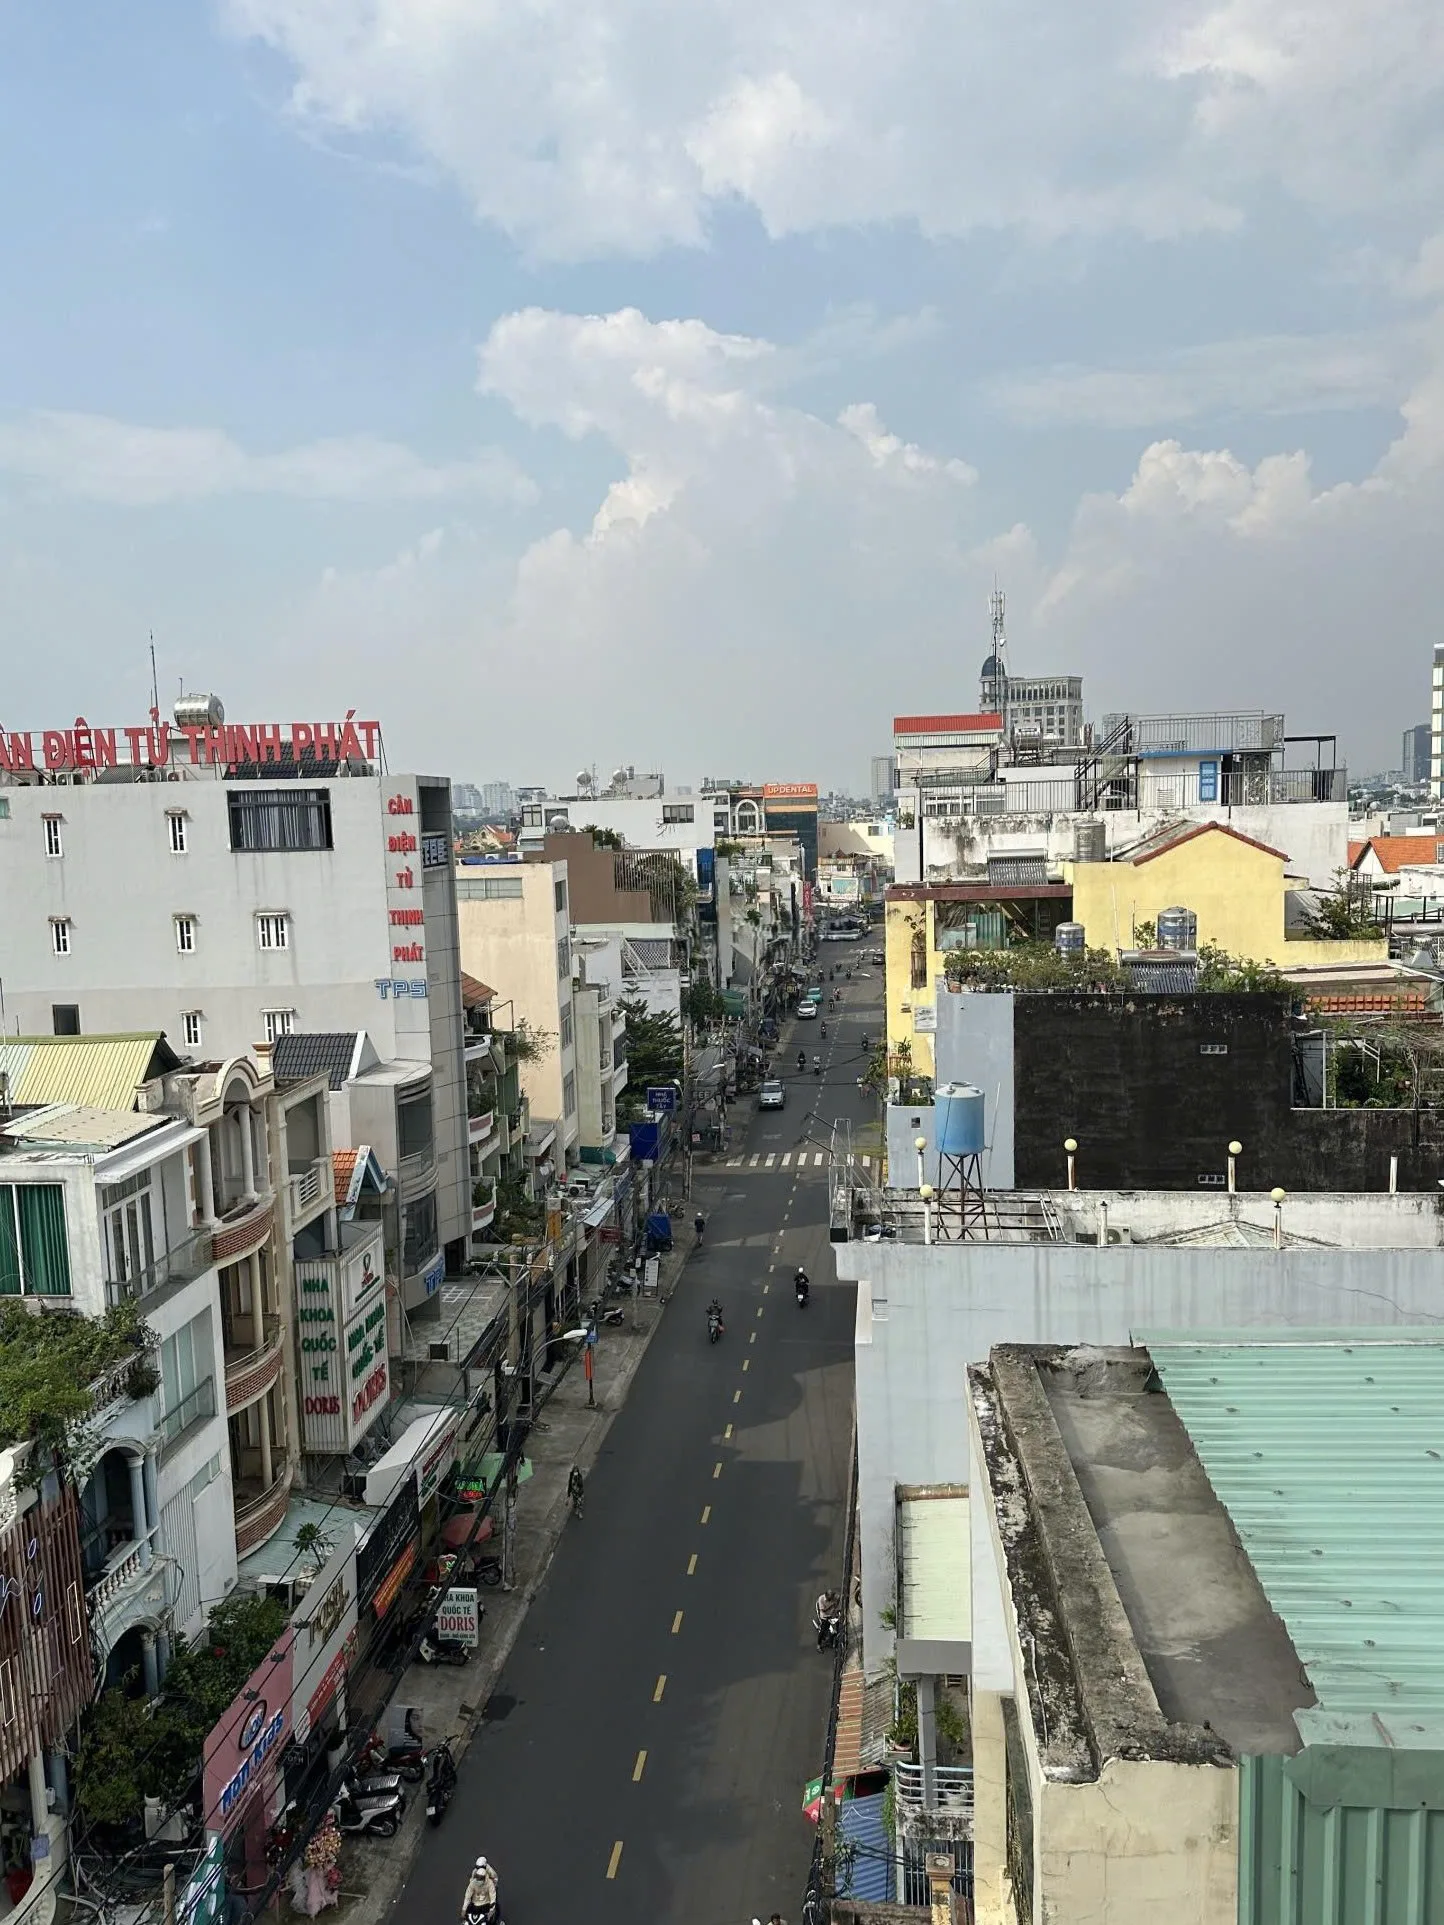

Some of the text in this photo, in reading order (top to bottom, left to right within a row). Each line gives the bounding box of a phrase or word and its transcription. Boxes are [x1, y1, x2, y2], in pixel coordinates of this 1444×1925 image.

[43, 717, 117, 777] ĐIỆN
[125, 707, 170, 768] TỬ
[181, 723, 281, 774] THỊNH
[292, 709, 380, 762] PHÁT
[393, 942, 424, 961] PHÁT
[375, 979, 428, 999] TPS
[303, 1279, 329, 1293] NHA
[299, 1307, 335, 1322] KHOA
[301, 1330, 337, 1353] QUỐC
[312, 1360, 329, 1381] TẾ
[305, 1395, 340, 1415] DORIS
[455, 1594, 475, 1603] KHOA
[440, 1615, 475, 1632] DORIS
